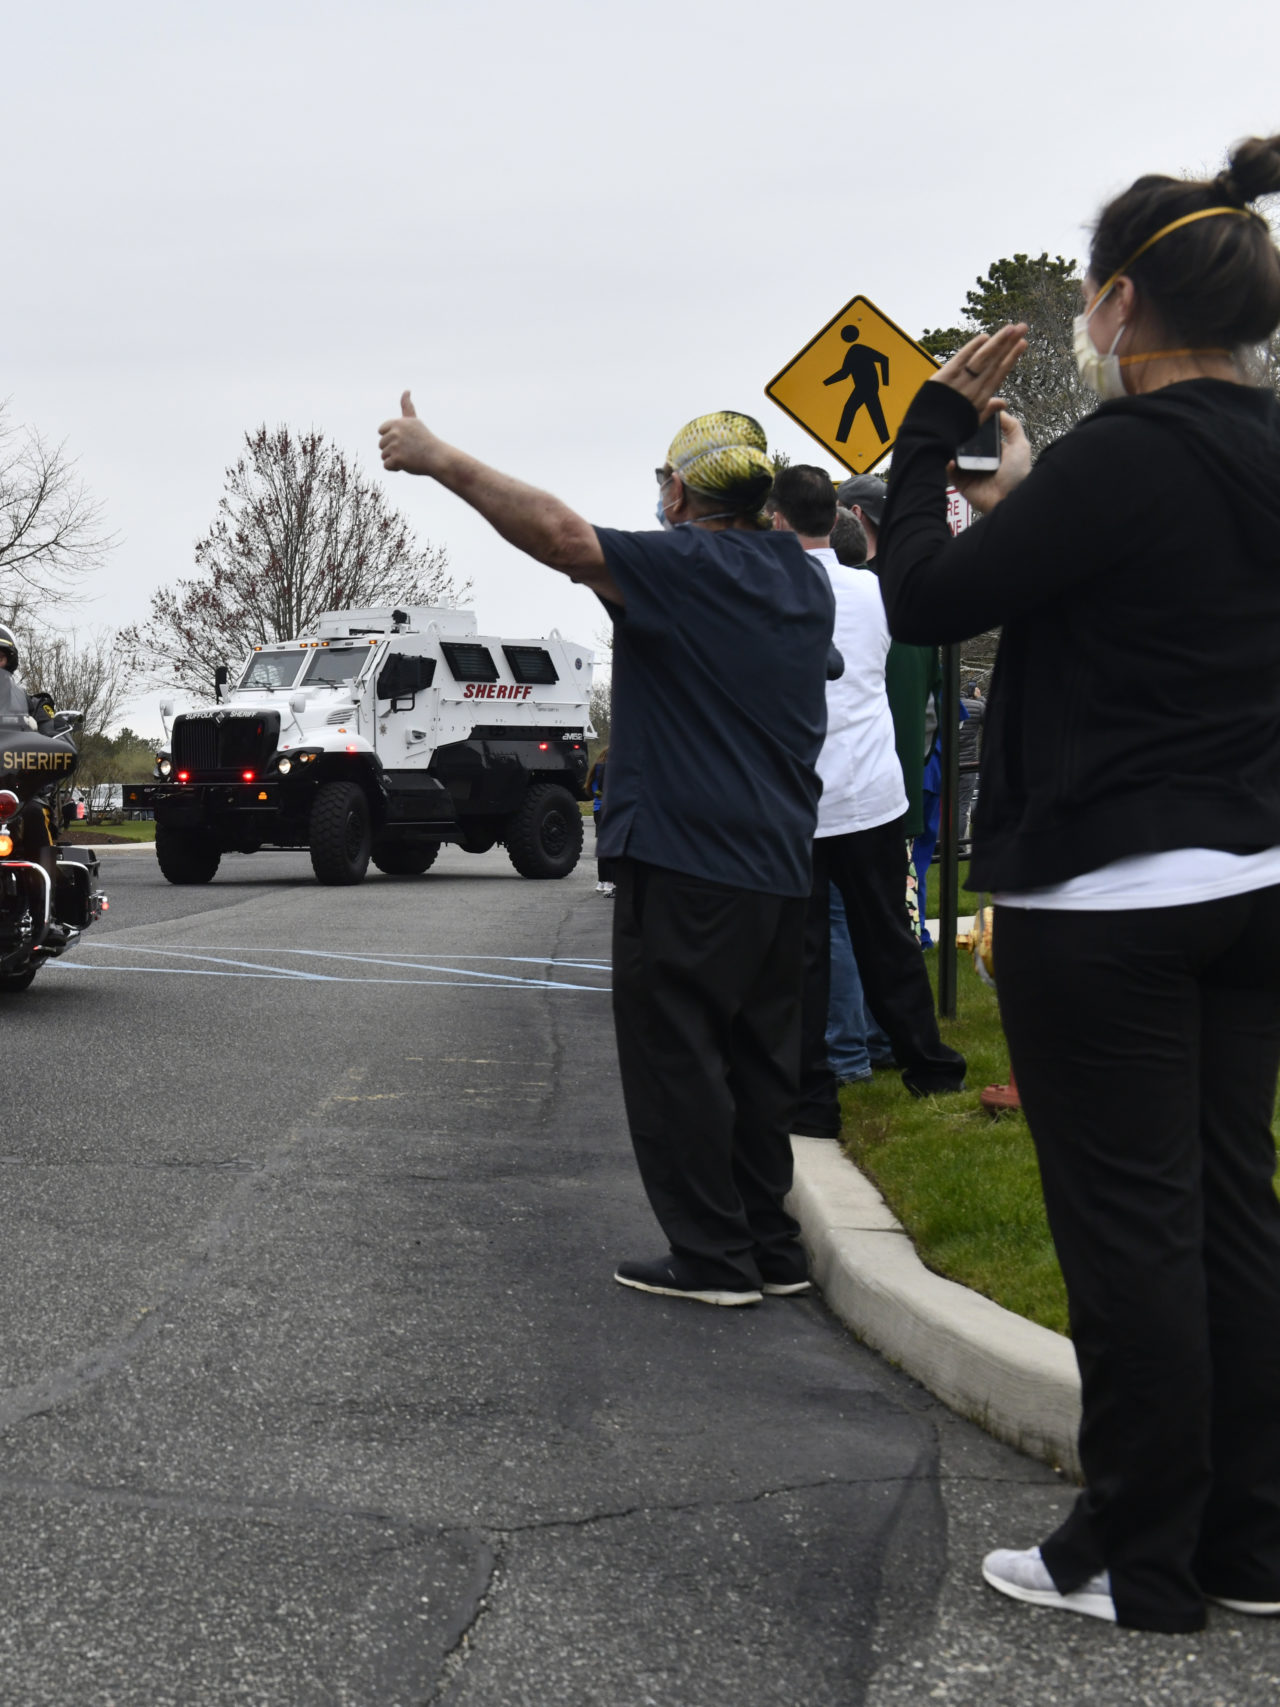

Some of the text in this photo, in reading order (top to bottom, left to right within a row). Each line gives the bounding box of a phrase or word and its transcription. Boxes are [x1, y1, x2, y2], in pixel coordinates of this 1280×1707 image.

[463, 684, 532, 699] SHERIFF
[185, 710, 256, 720] SUFFOLK SHERIFF
[3, 751, 73, 770] SHERIFF
